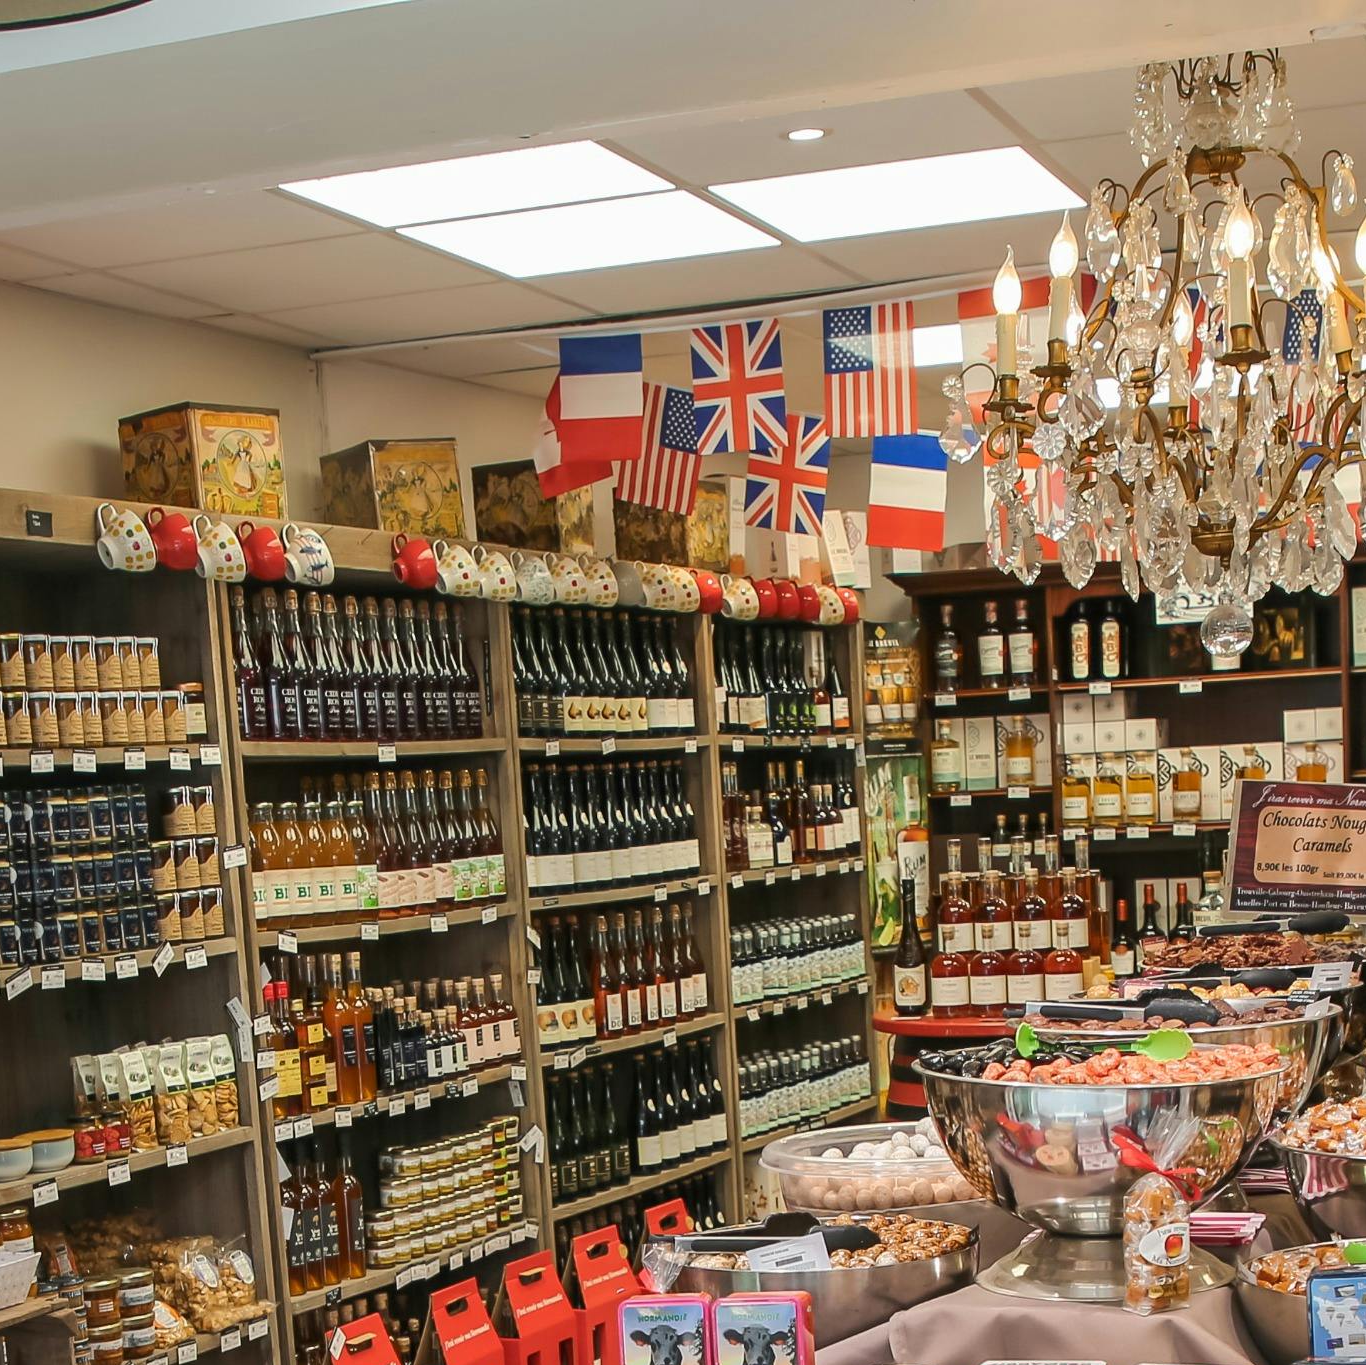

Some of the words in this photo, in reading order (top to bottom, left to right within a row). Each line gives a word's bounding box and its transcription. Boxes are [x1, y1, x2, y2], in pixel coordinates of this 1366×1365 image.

[1262, 811, 1328, 828] Chocolats
[1293, 837, 1353, 853] Caramels
[1256, 862, 1281, 872] 8,90€
[1282, 863, 1293, 872] les
[1296, 863, 1320, 874] 100gr
[638, 1313, 688, 1323] NORMANDIE
[731, 1312, 780, 1322] NORMANDIE
